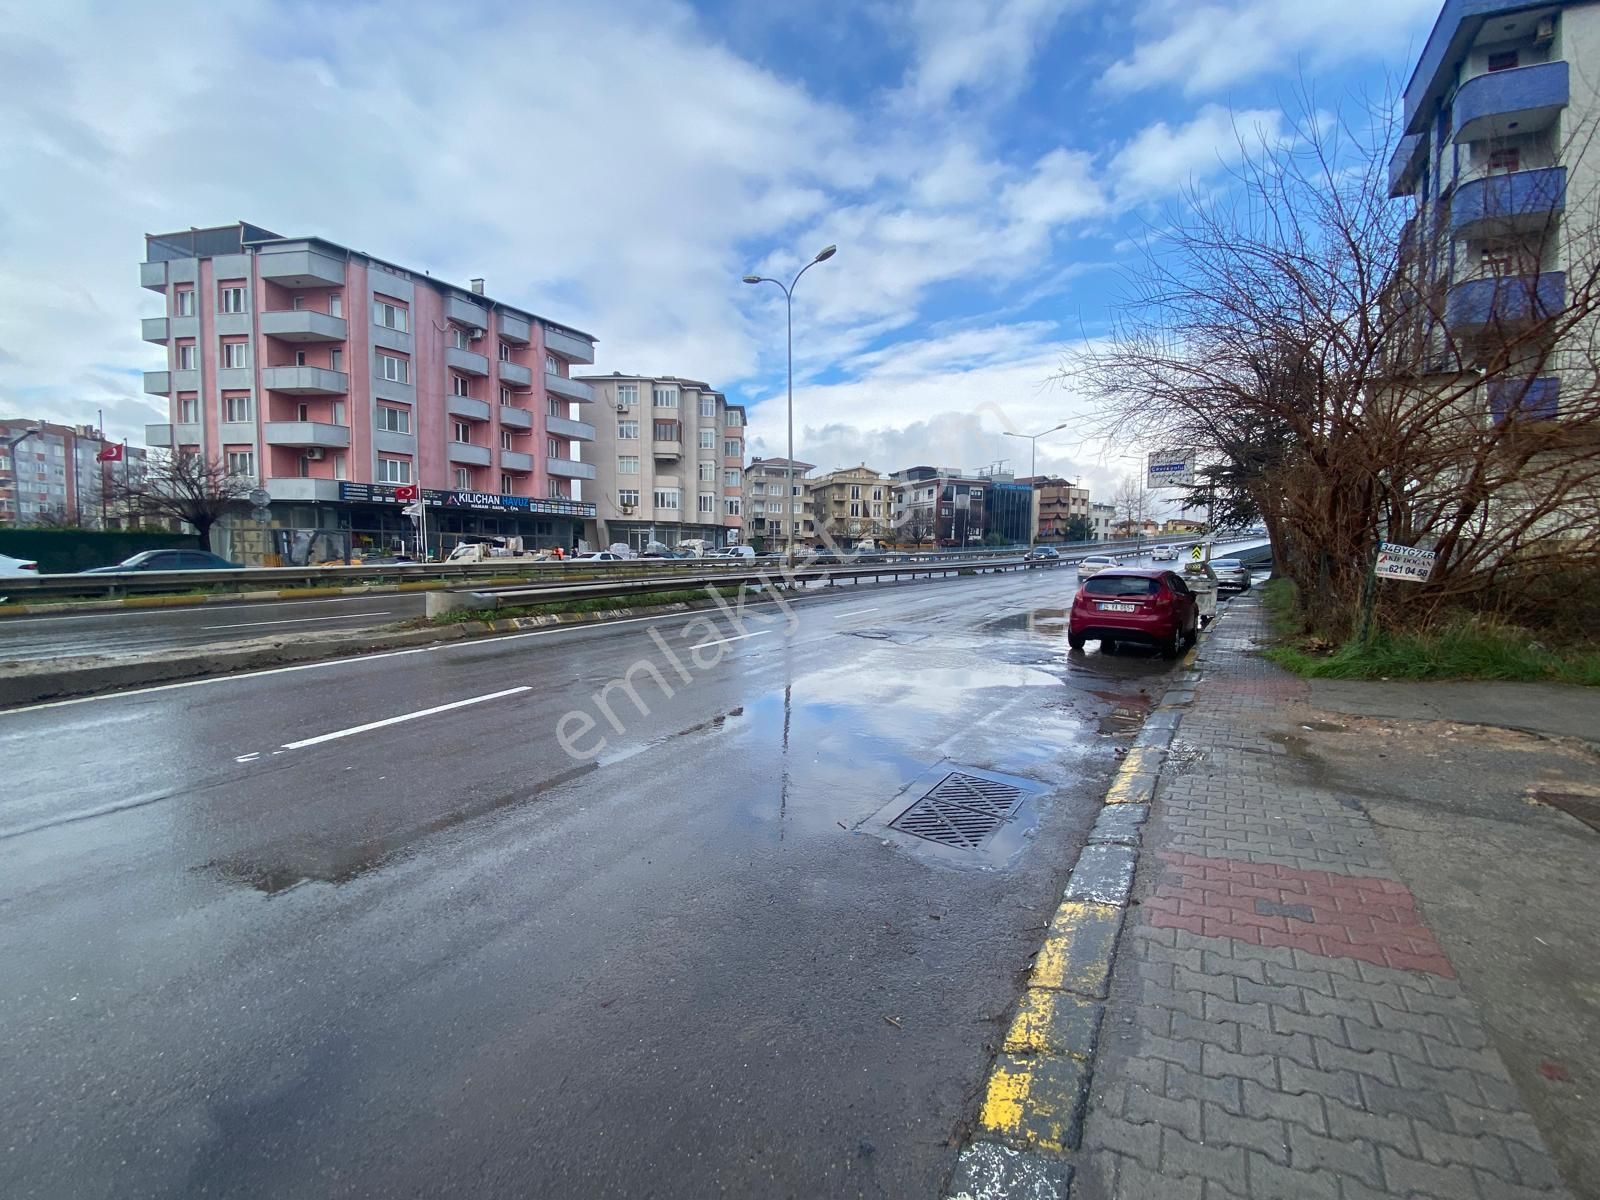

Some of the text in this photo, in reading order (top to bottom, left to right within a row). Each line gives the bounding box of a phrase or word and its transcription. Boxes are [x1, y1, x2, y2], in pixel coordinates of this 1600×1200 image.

[459, 492, 529, 507] KILIÇHAN HAVUZ
[1388, 564, 1404, 574] 621
[1405, 566, 1416, 576] 04
[1416, 568, 1429, 577] 58
